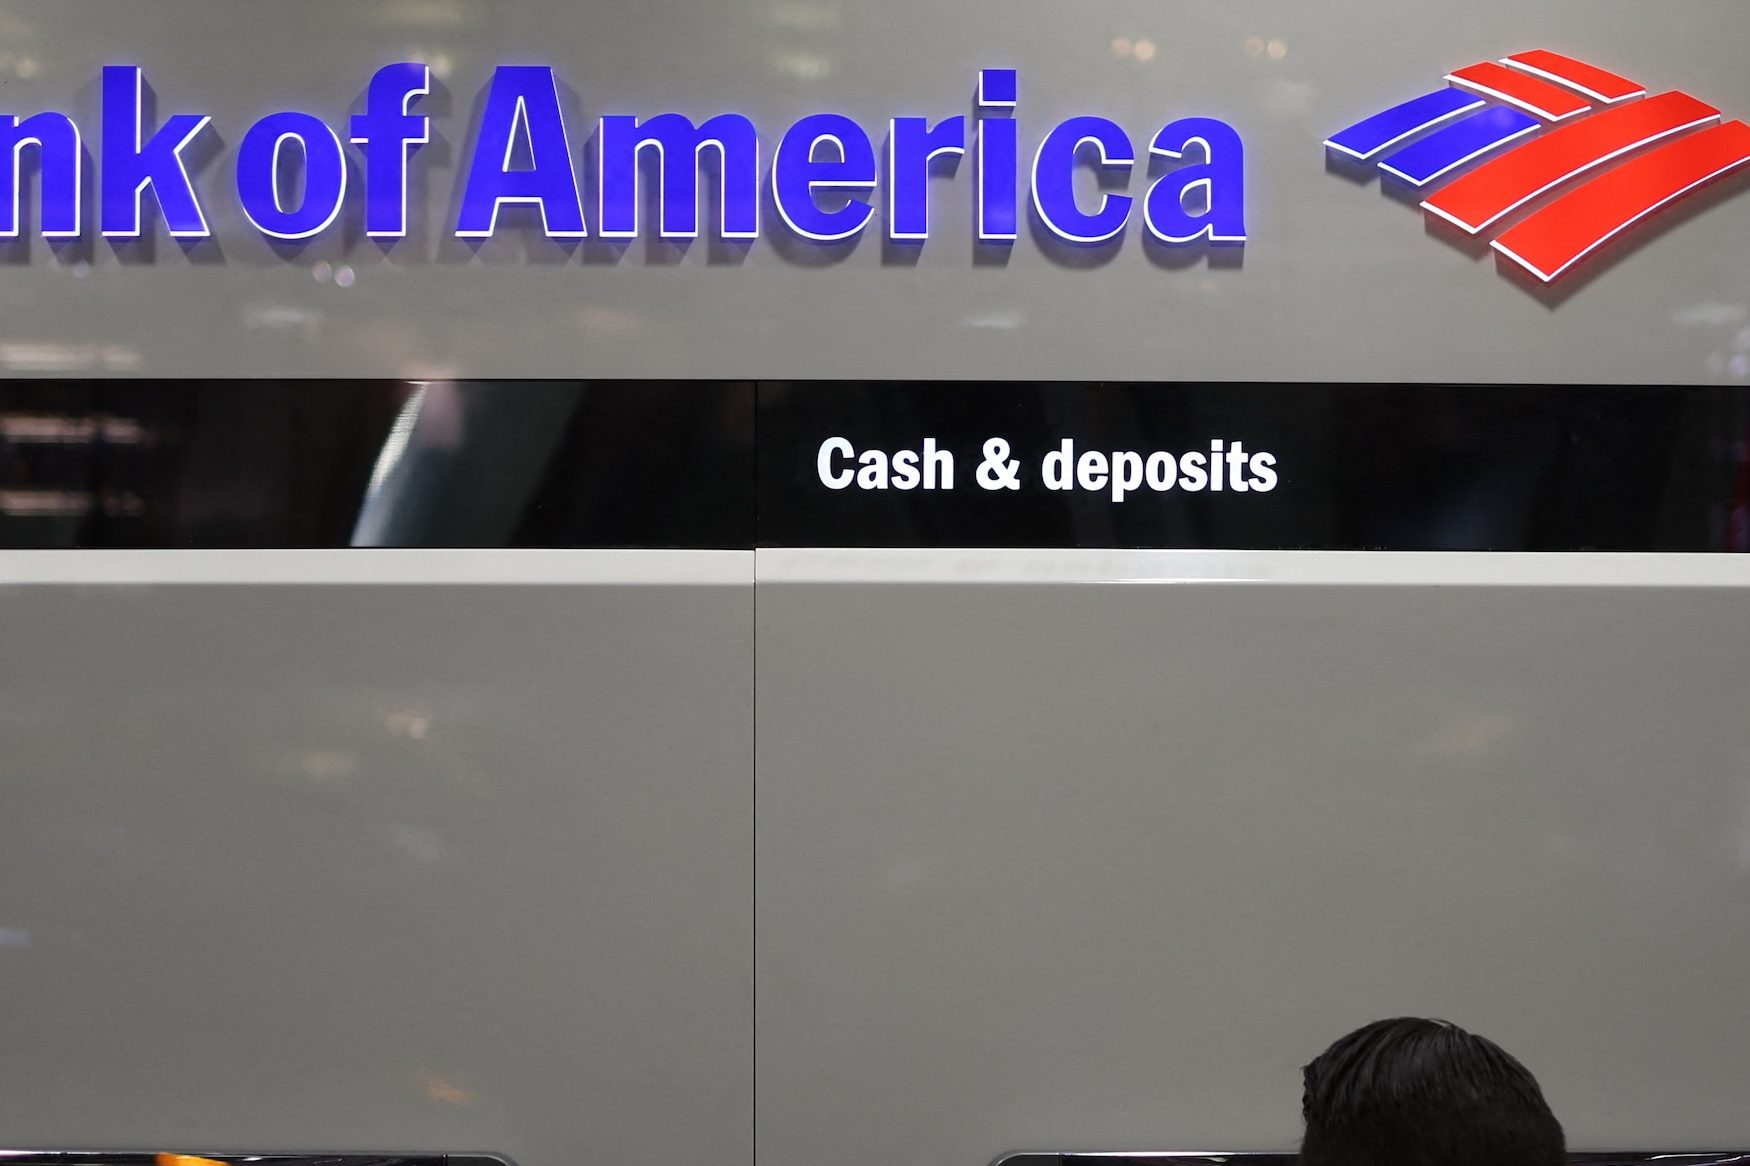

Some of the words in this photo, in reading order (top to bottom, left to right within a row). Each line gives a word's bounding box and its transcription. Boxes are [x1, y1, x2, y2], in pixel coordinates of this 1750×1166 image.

[237, 63, 429, 239] of
[455, 66, 1247, 243] America
[817, 437, 954, 490] Cash
[975, 437, 1020, 490] &
[1042, 438, 1278, 502] deposits
